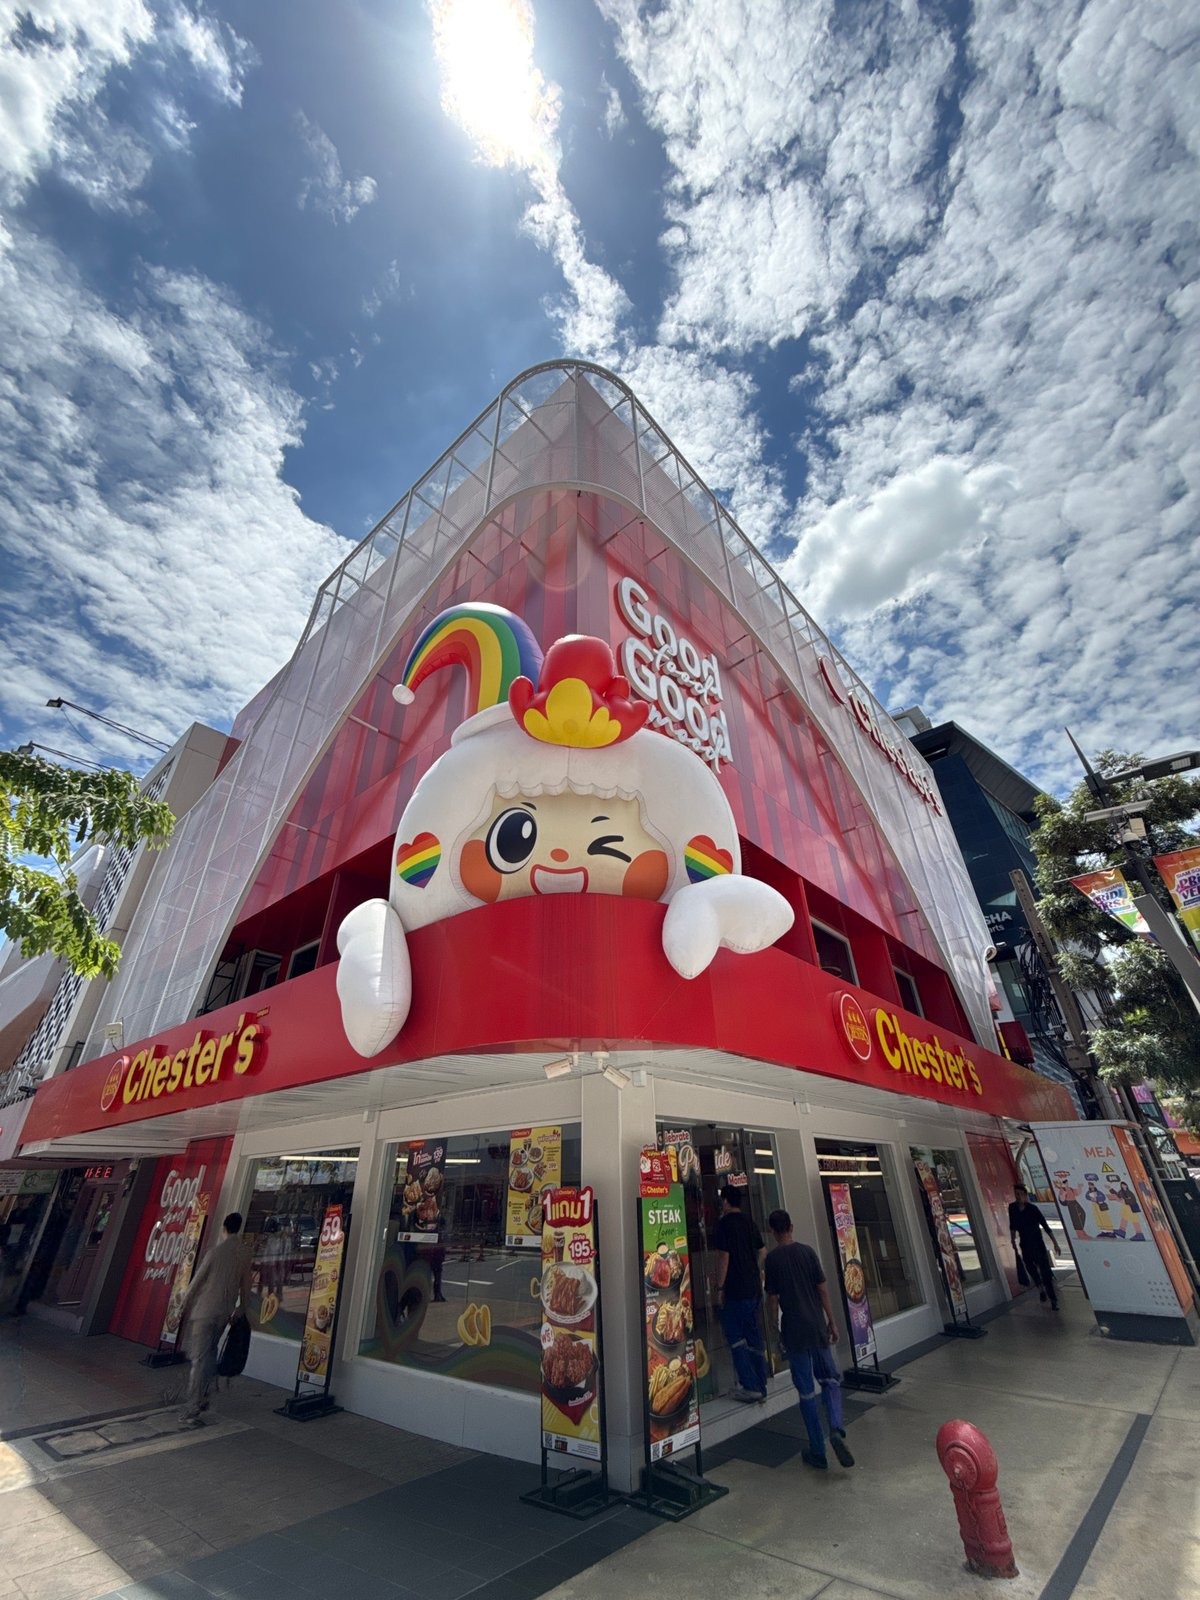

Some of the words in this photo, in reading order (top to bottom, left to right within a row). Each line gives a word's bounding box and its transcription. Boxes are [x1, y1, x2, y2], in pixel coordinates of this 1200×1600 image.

[617, 576, 724, 701] Good
[621, 636, 734, 763] Good
[123, 1013, 257, 1105] Chester's
[875, 1008, 983, 1096] Chester's
[160, 1165, 207, 1209] Good
[1083, 1146, 1116, 1159] MEA
[648, 1209, 682, 1225] STEAK
